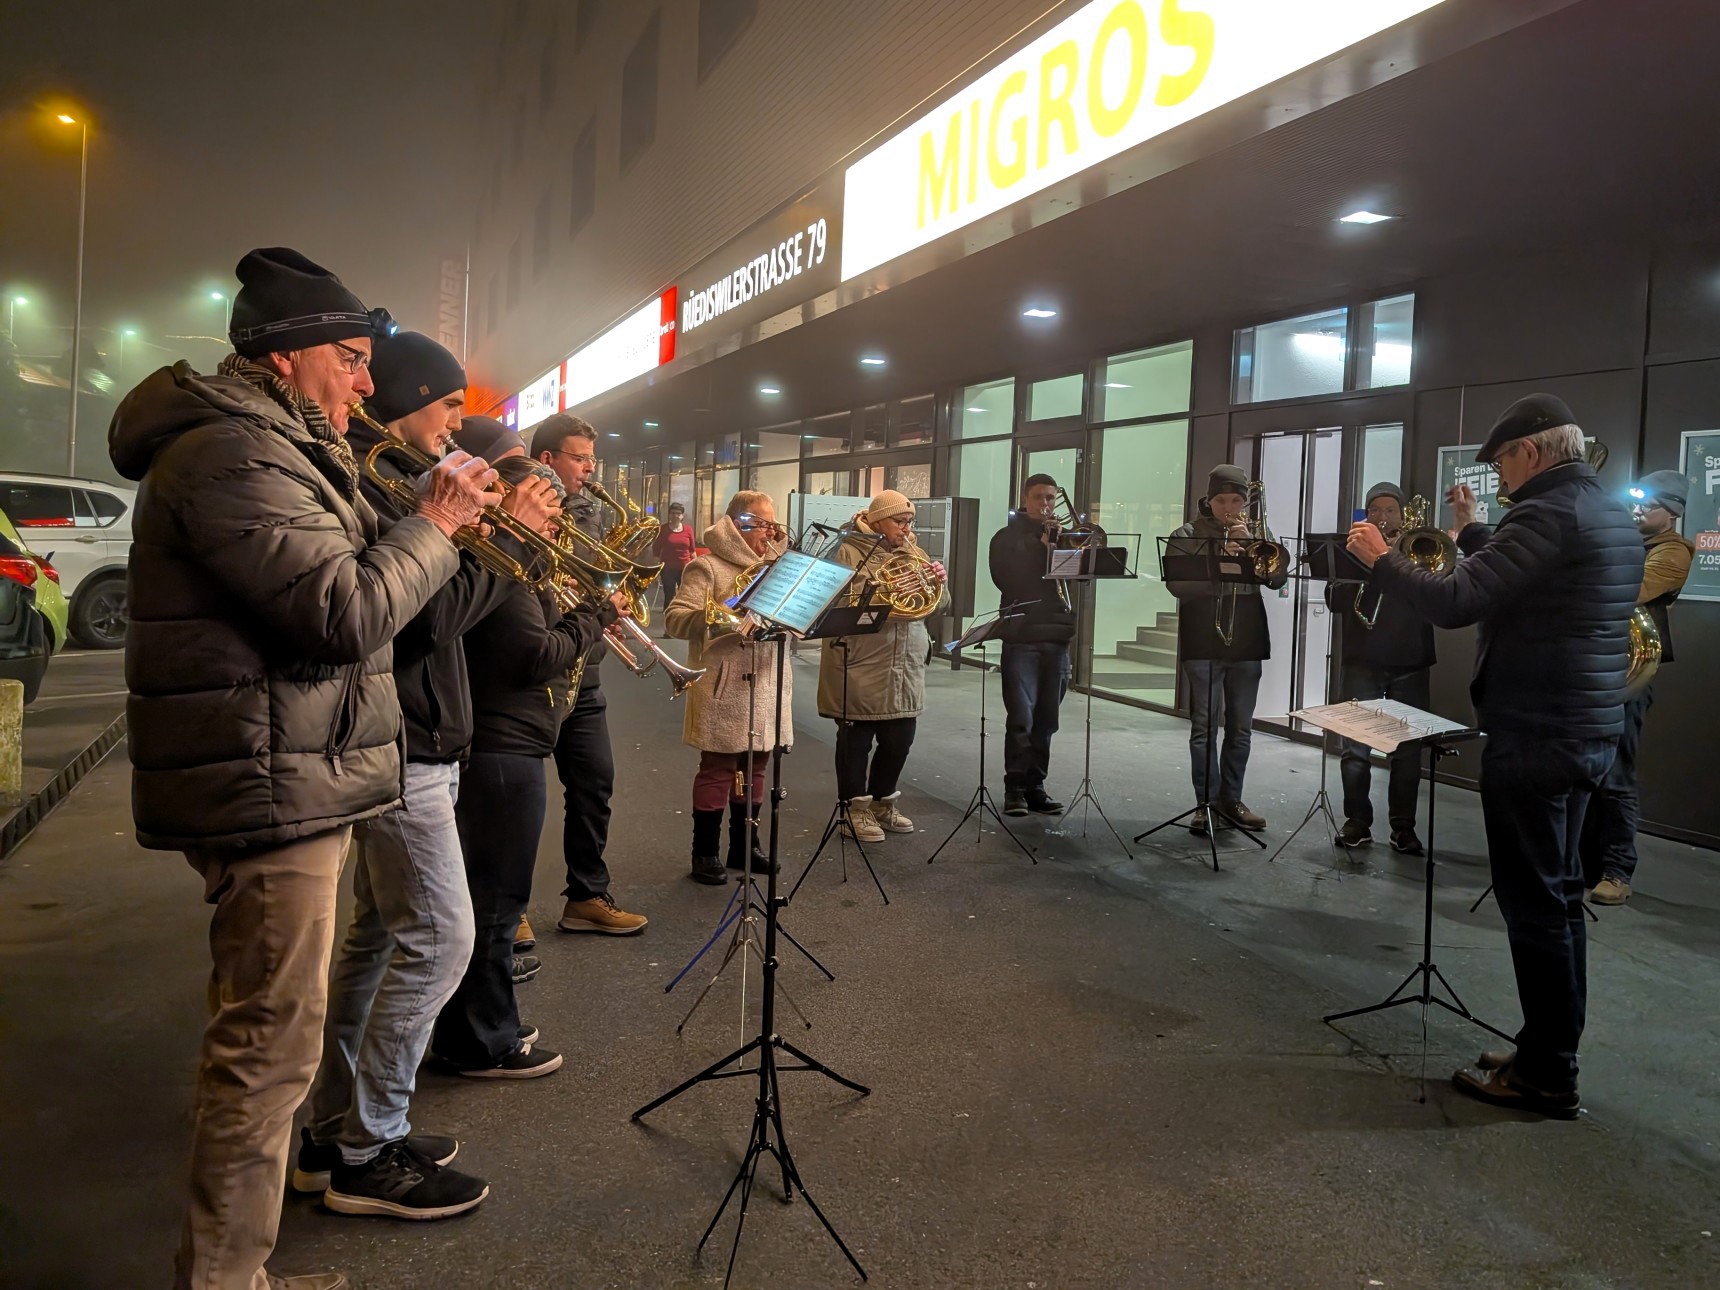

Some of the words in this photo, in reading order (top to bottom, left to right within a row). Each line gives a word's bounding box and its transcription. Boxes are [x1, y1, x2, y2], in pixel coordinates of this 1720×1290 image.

[916, 0, 1215, 230] MIGROS
[439, 260, 462, 350] ENNER
[682, 231, 803, 333] RÜEDISWILERSTRASSE
[807, 218, 827, 269] 79
[1454, 464, 1486, 478] Sparen
